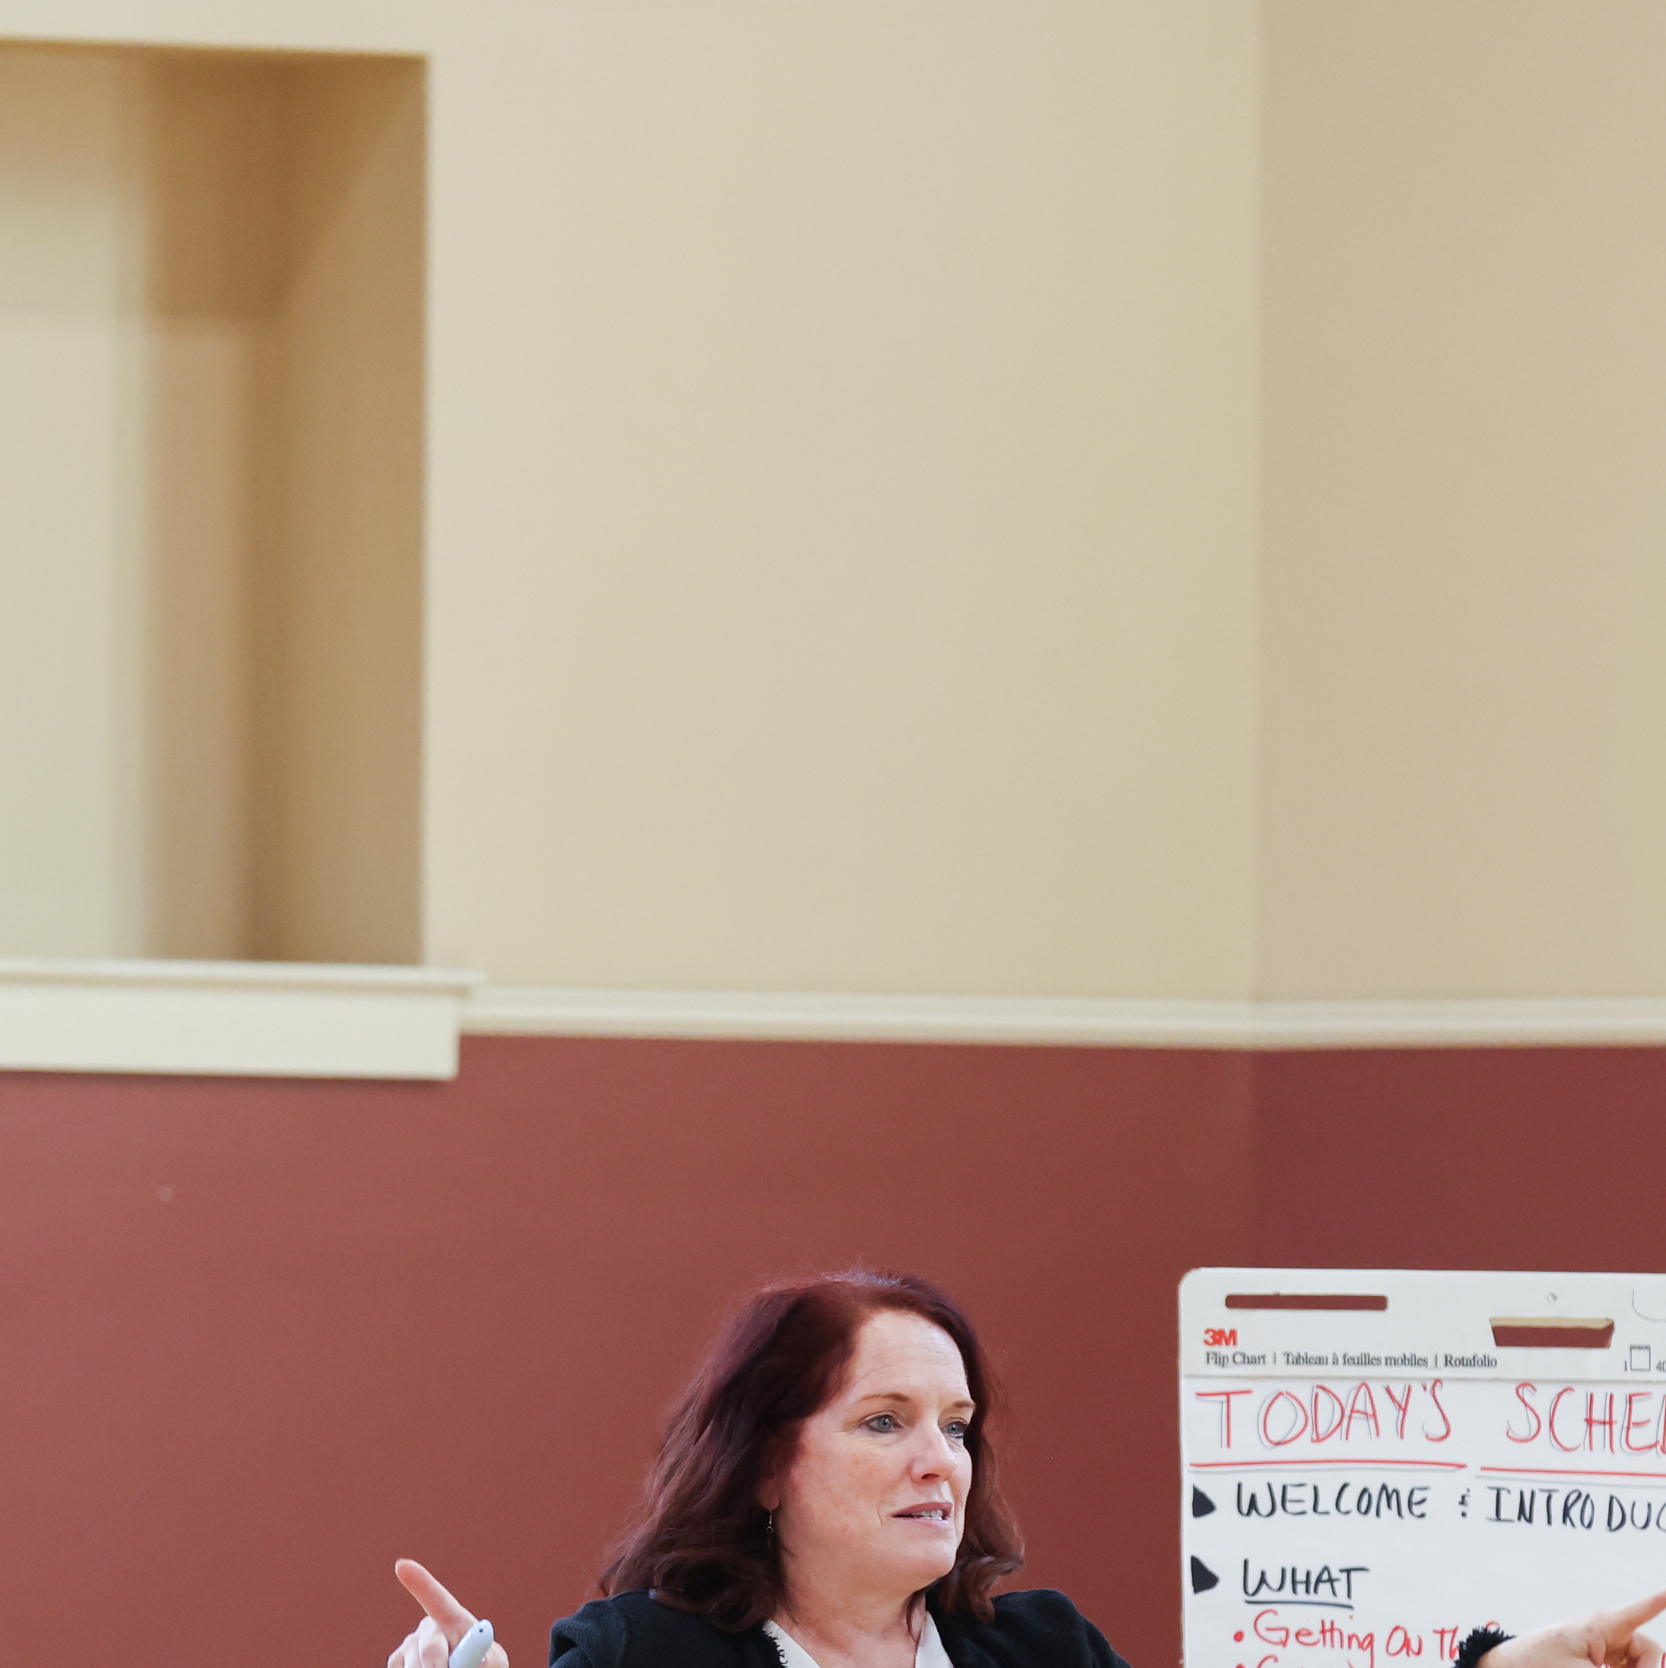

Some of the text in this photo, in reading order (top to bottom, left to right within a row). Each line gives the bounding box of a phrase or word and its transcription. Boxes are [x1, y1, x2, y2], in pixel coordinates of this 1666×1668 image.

[1203, 1328, 1237, 1346] 3M
[1205, 1352, 1229, 1367] Flip
[1233, 1352, 1266, 1365] Chart
[1284, 1353, 1329, 1366] Tableau
[1342, 1353, 1382, 1367] feuilles
[1384, 1354, 1429, 1367] mobiles
[1443, 1354, 1498, 1368] Rotafolio
[1195, 1379, 1452, 1449] TODAY'S
[1236, 1482, 1431, 1519] WELCOME
[1243, 1558, 1370, 1600] WHAT
[1433, 1625, 1460, 1661] Th
